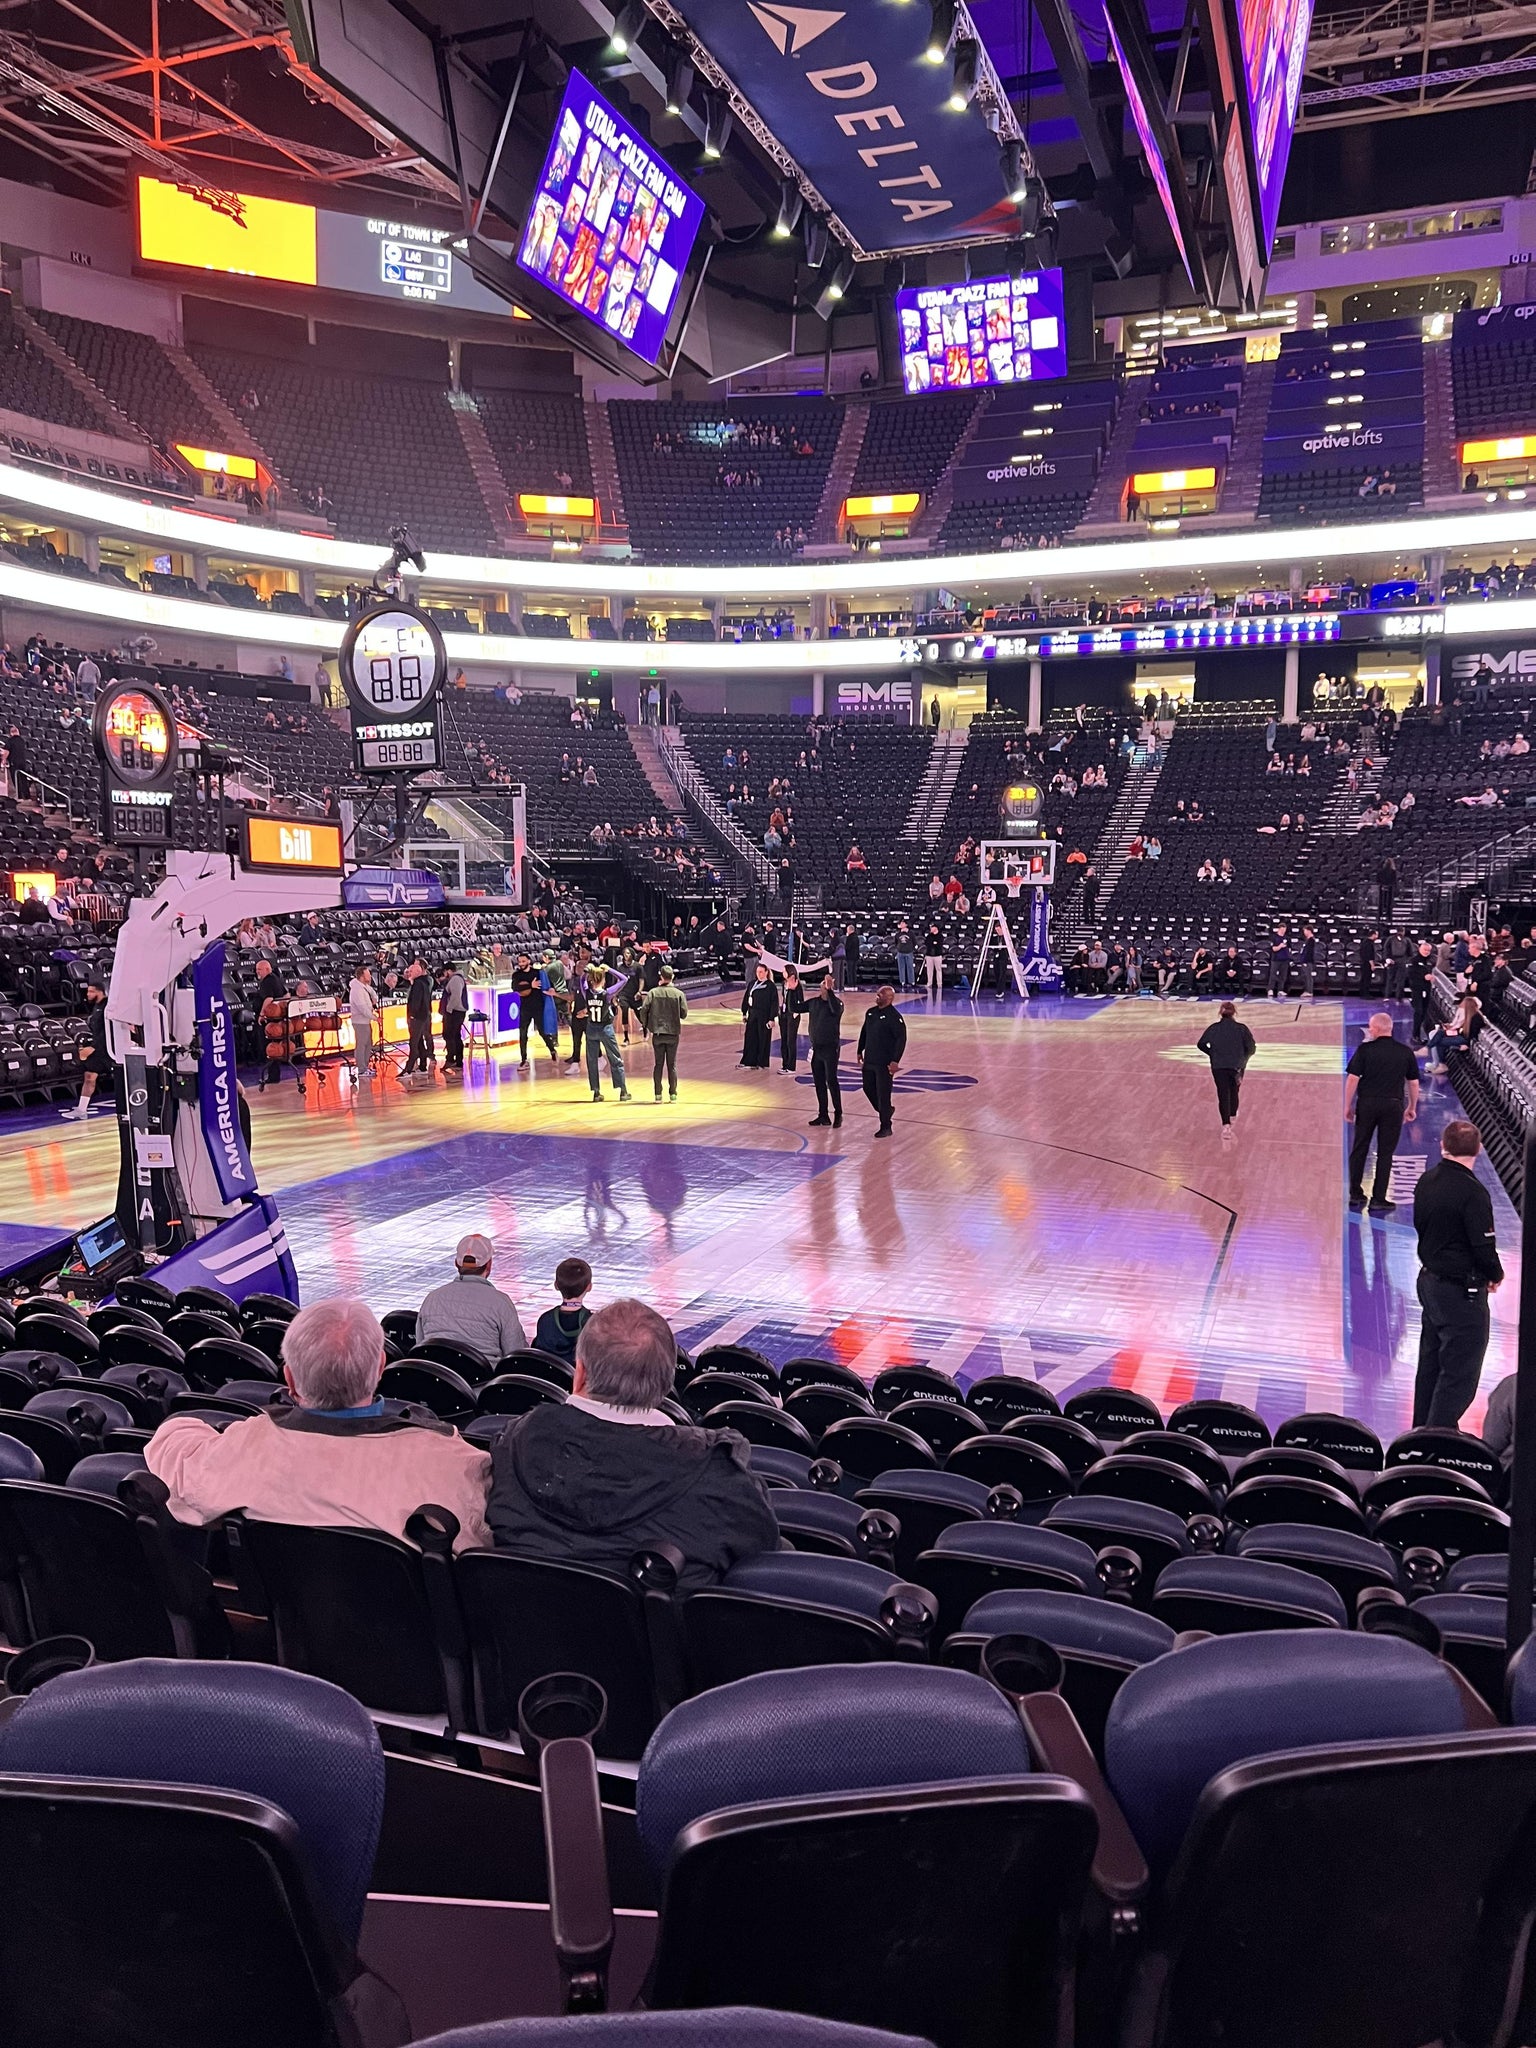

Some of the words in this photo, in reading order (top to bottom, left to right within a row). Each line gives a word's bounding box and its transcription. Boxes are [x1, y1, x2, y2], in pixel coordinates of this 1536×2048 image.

[806, 61, 953, 222] DELTA
[585, 101, 616, 147] UTAH
[616, 134, 649, 180] JAZZ
[643, 161, 667, 198] FAN
[663, 181, 687, 219] CAM
[368, 219, 386, 235] OUT
[388, 222, 401, 237] OF
[402, 226, 430, 242] TOWN
[423, 288, 437, 300] PM
[918, 290, 947, 308] UTAH
[952, 284, 986, 303] JAZZ
[987, 282, 1010, 299] FAN
[1011, 277, 1039, 295] CAM
[1514, 306, 1536, 320] ap
[1303, 434, 1351, 453] aptive
[1351, 430, 1383, 447] lofts
[987, 464, 1028, 482] aptive
[1029, 462, 1056, 478] lofts
[1422, 614, 1444, 634] PM
[838, 682, 912, 703] SME
[840, 704, 911, 712] INDUSTRIES
[377, 722, 434, 739] TISSOT
[130, 791, 173, 806] TISSOT
[280, 827, 313, 862] bill
[1033, 923, 1041, 954] AMERICA
[589, 1006, 602, 1023] 11
[210, 996, 228, 1067] FIRST
[214, 1070, 247, 1181] AMERICA
[913, 1390, 957, 1403] entrata
[1006, 1402, 1051, 1415] entrata
[1107, 1414, 1155, 1425] entrata
[1212, 1427, 1262, 1439] entrata
[1438, 1457, 1493, 1471] entrata
